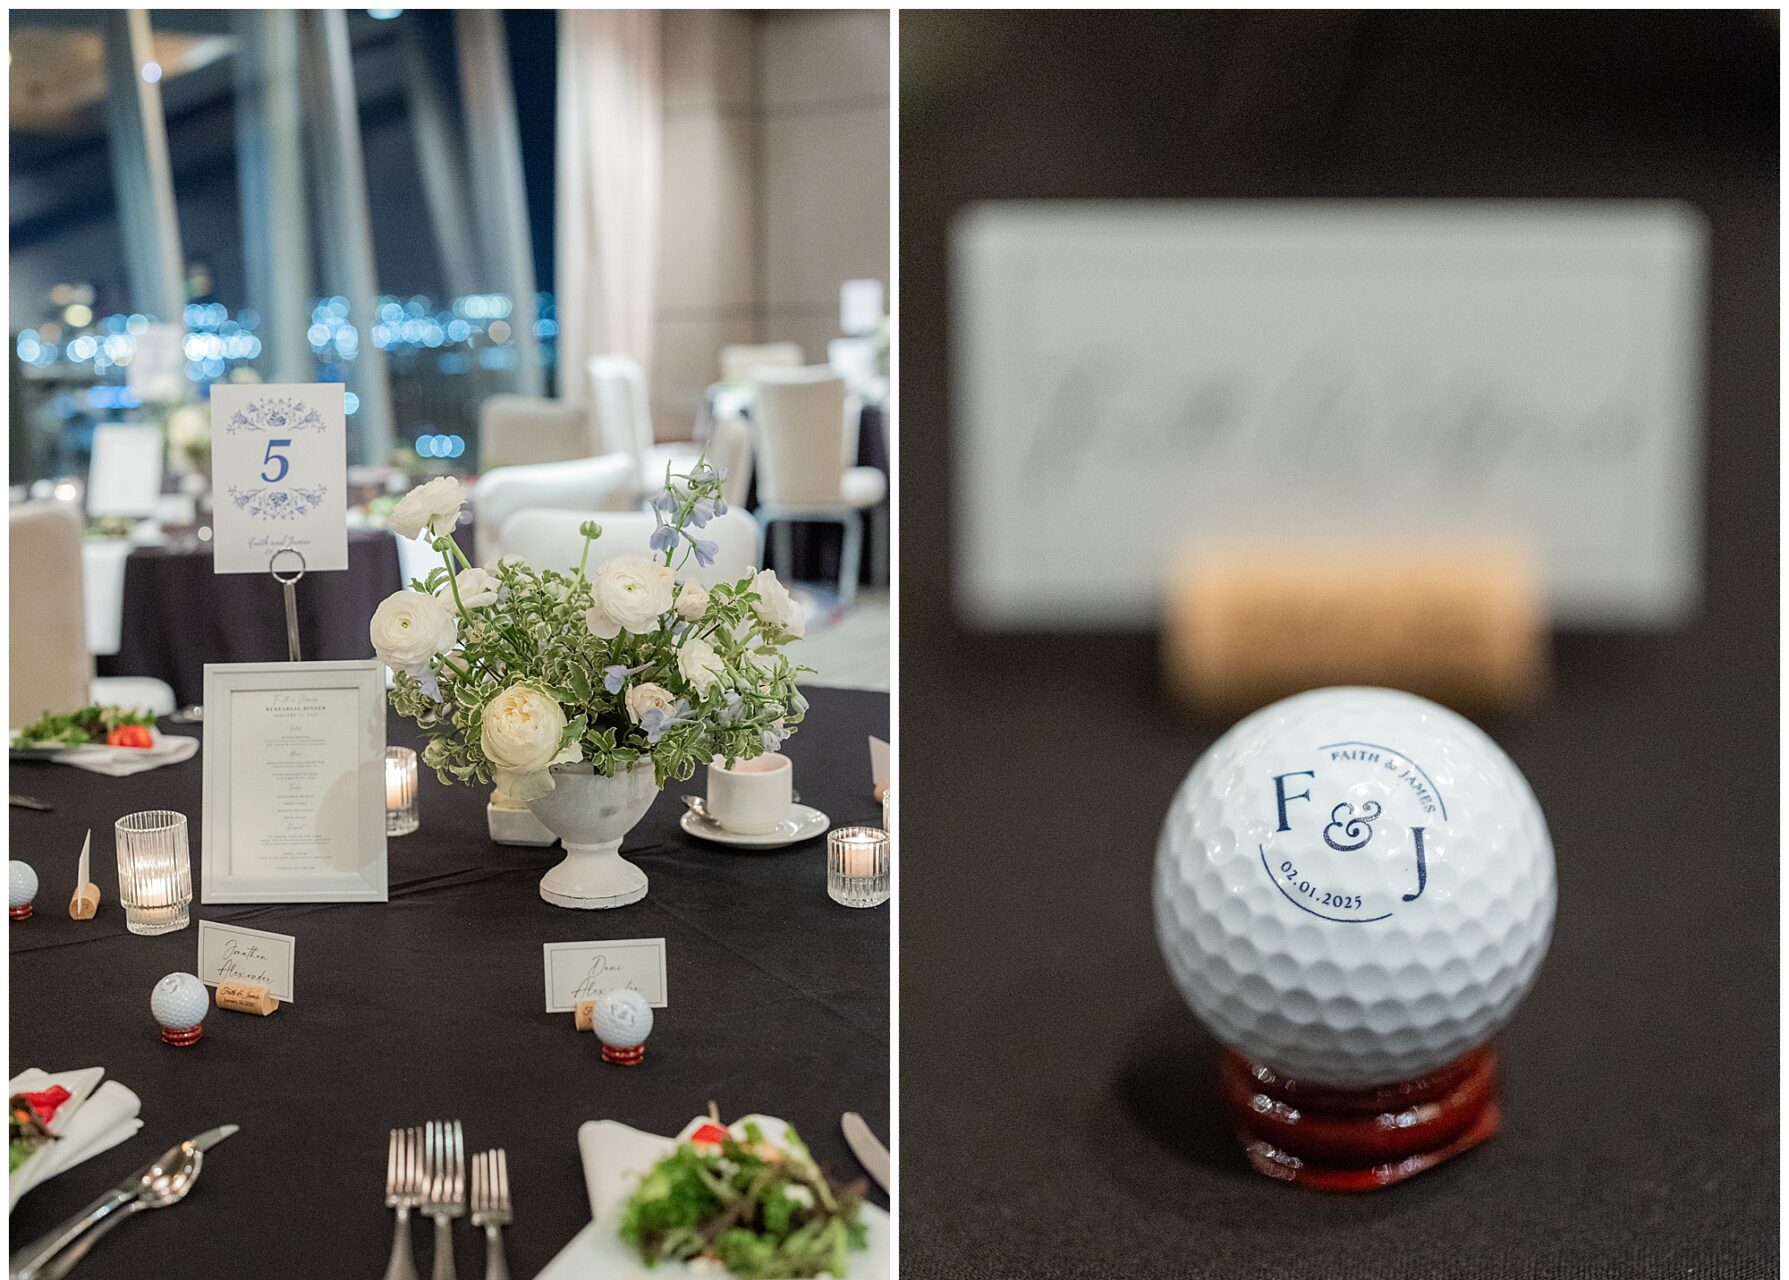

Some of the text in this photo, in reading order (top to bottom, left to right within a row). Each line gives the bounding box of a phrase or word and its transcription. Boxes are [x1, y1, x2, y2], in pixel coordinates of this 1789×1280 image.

[260, 438, 293, 484] 5
[1330, 749, 1437, 814] FAITH & JAMES
[1272, 770, 1428, 902] F & J
[1280, 860, 1363, 910] 02.01.2025
[216, 958, 274, 984] Alexander
[222, 938, 269, 962] Jonathan
